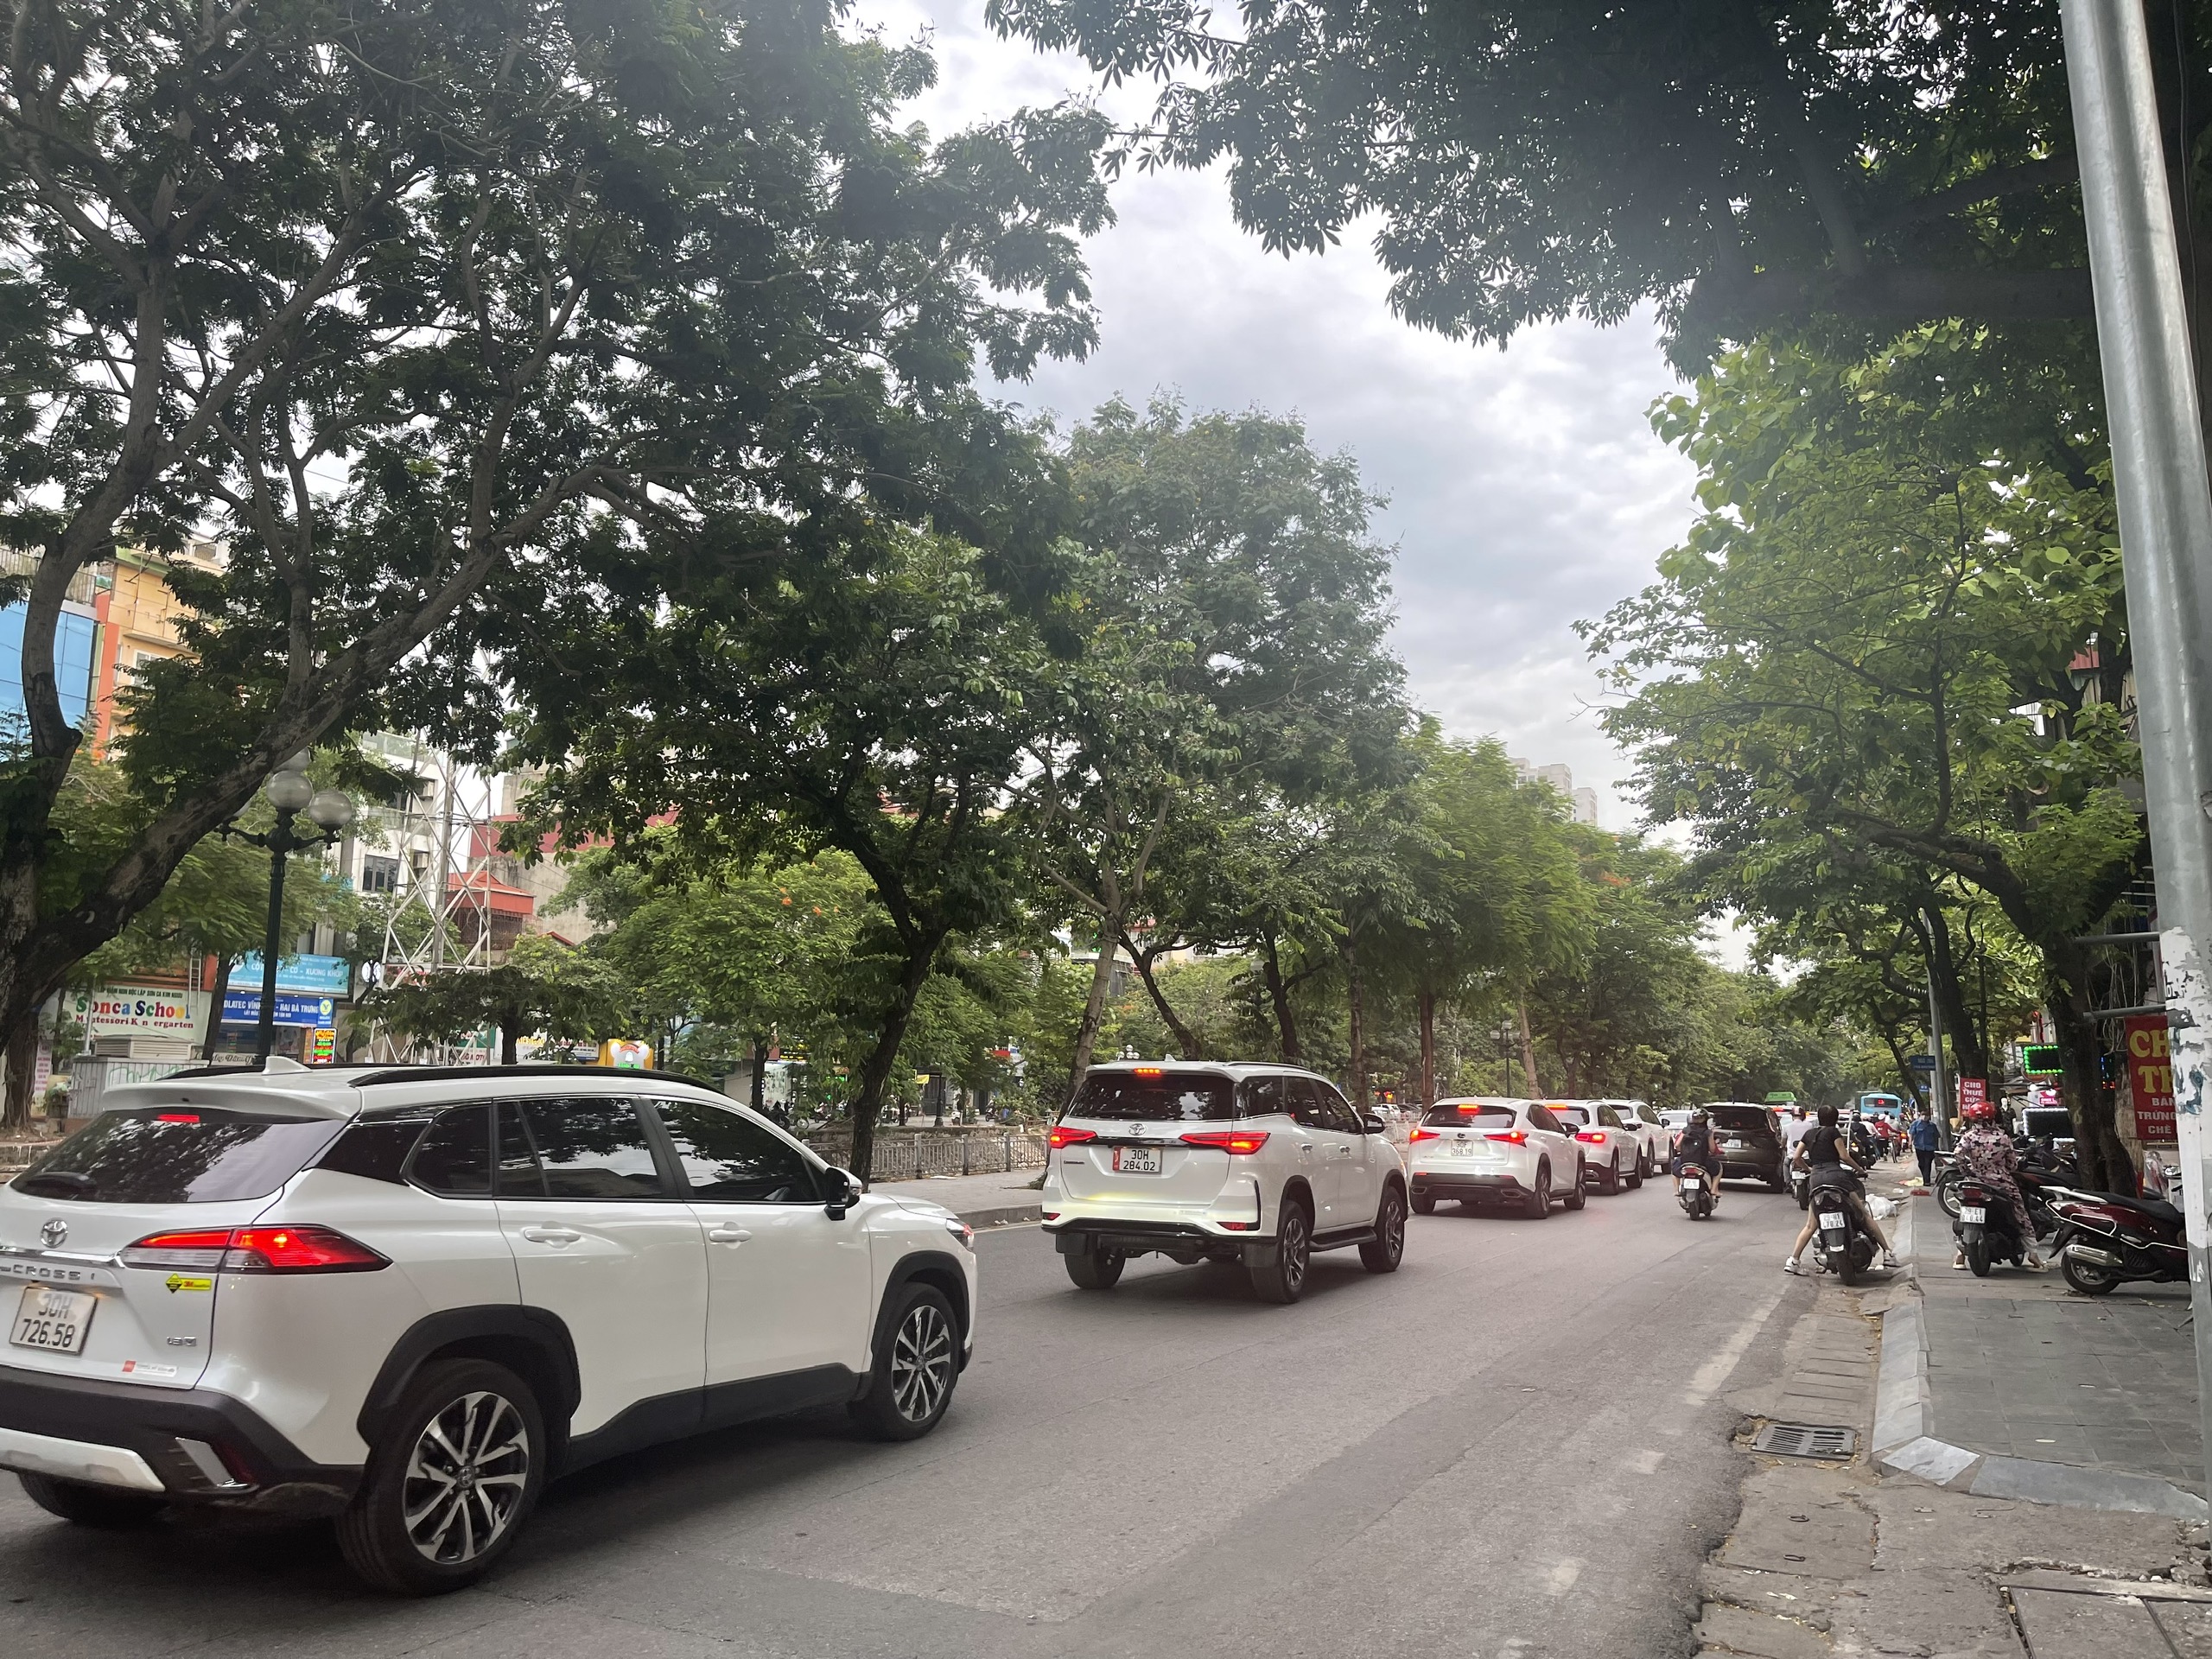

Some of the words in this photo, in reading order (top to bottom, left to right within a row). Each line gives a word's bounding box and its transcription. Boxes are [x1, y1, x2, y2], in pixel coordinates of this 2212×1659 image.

[135, 1000, 191, 1019] School
[1131, 1150, 1149, 1160] 30H
[1123, 1160, 1155, 1171] 284.02
[38, 1293, 73, 1319] 30H
[20, 1319, 76, 1348] 726.58
